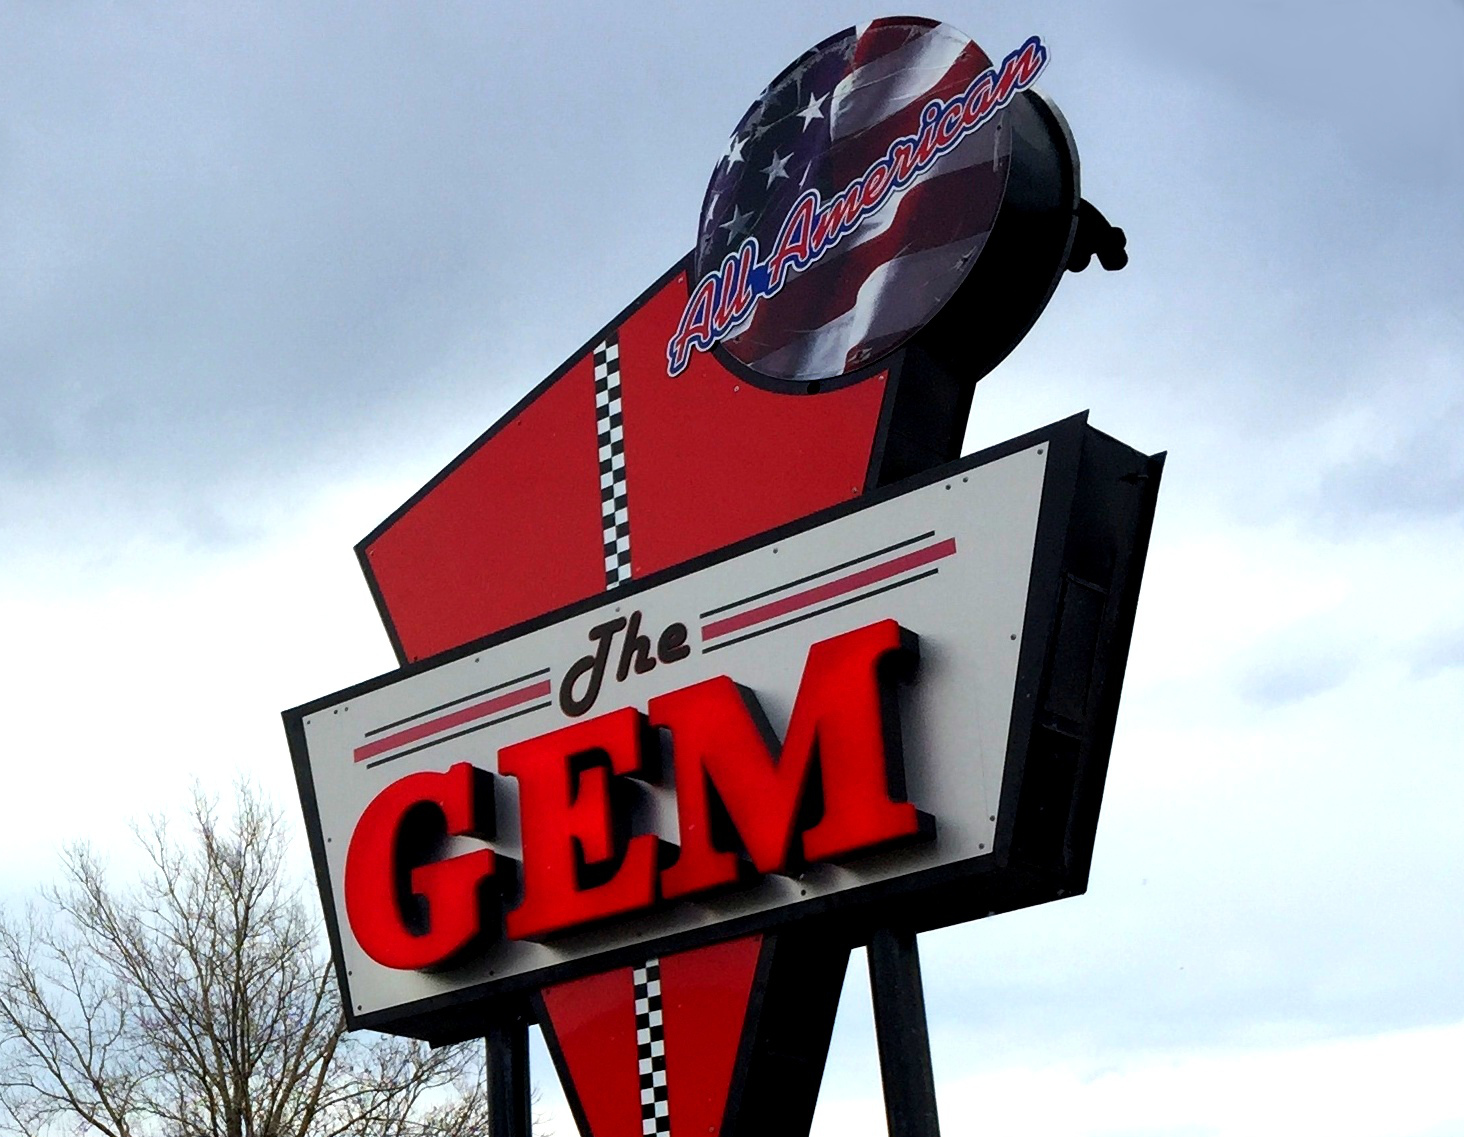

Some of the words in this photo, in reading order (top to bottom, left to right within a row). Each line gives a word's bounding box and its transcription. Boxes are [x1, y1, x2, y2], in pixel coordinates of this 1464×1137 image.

[668, 236, 761, 377] All
[764, 33, 1050, 298] American
[344, 618, 928, 972] GEM
[559, 610, 691, 717] The
